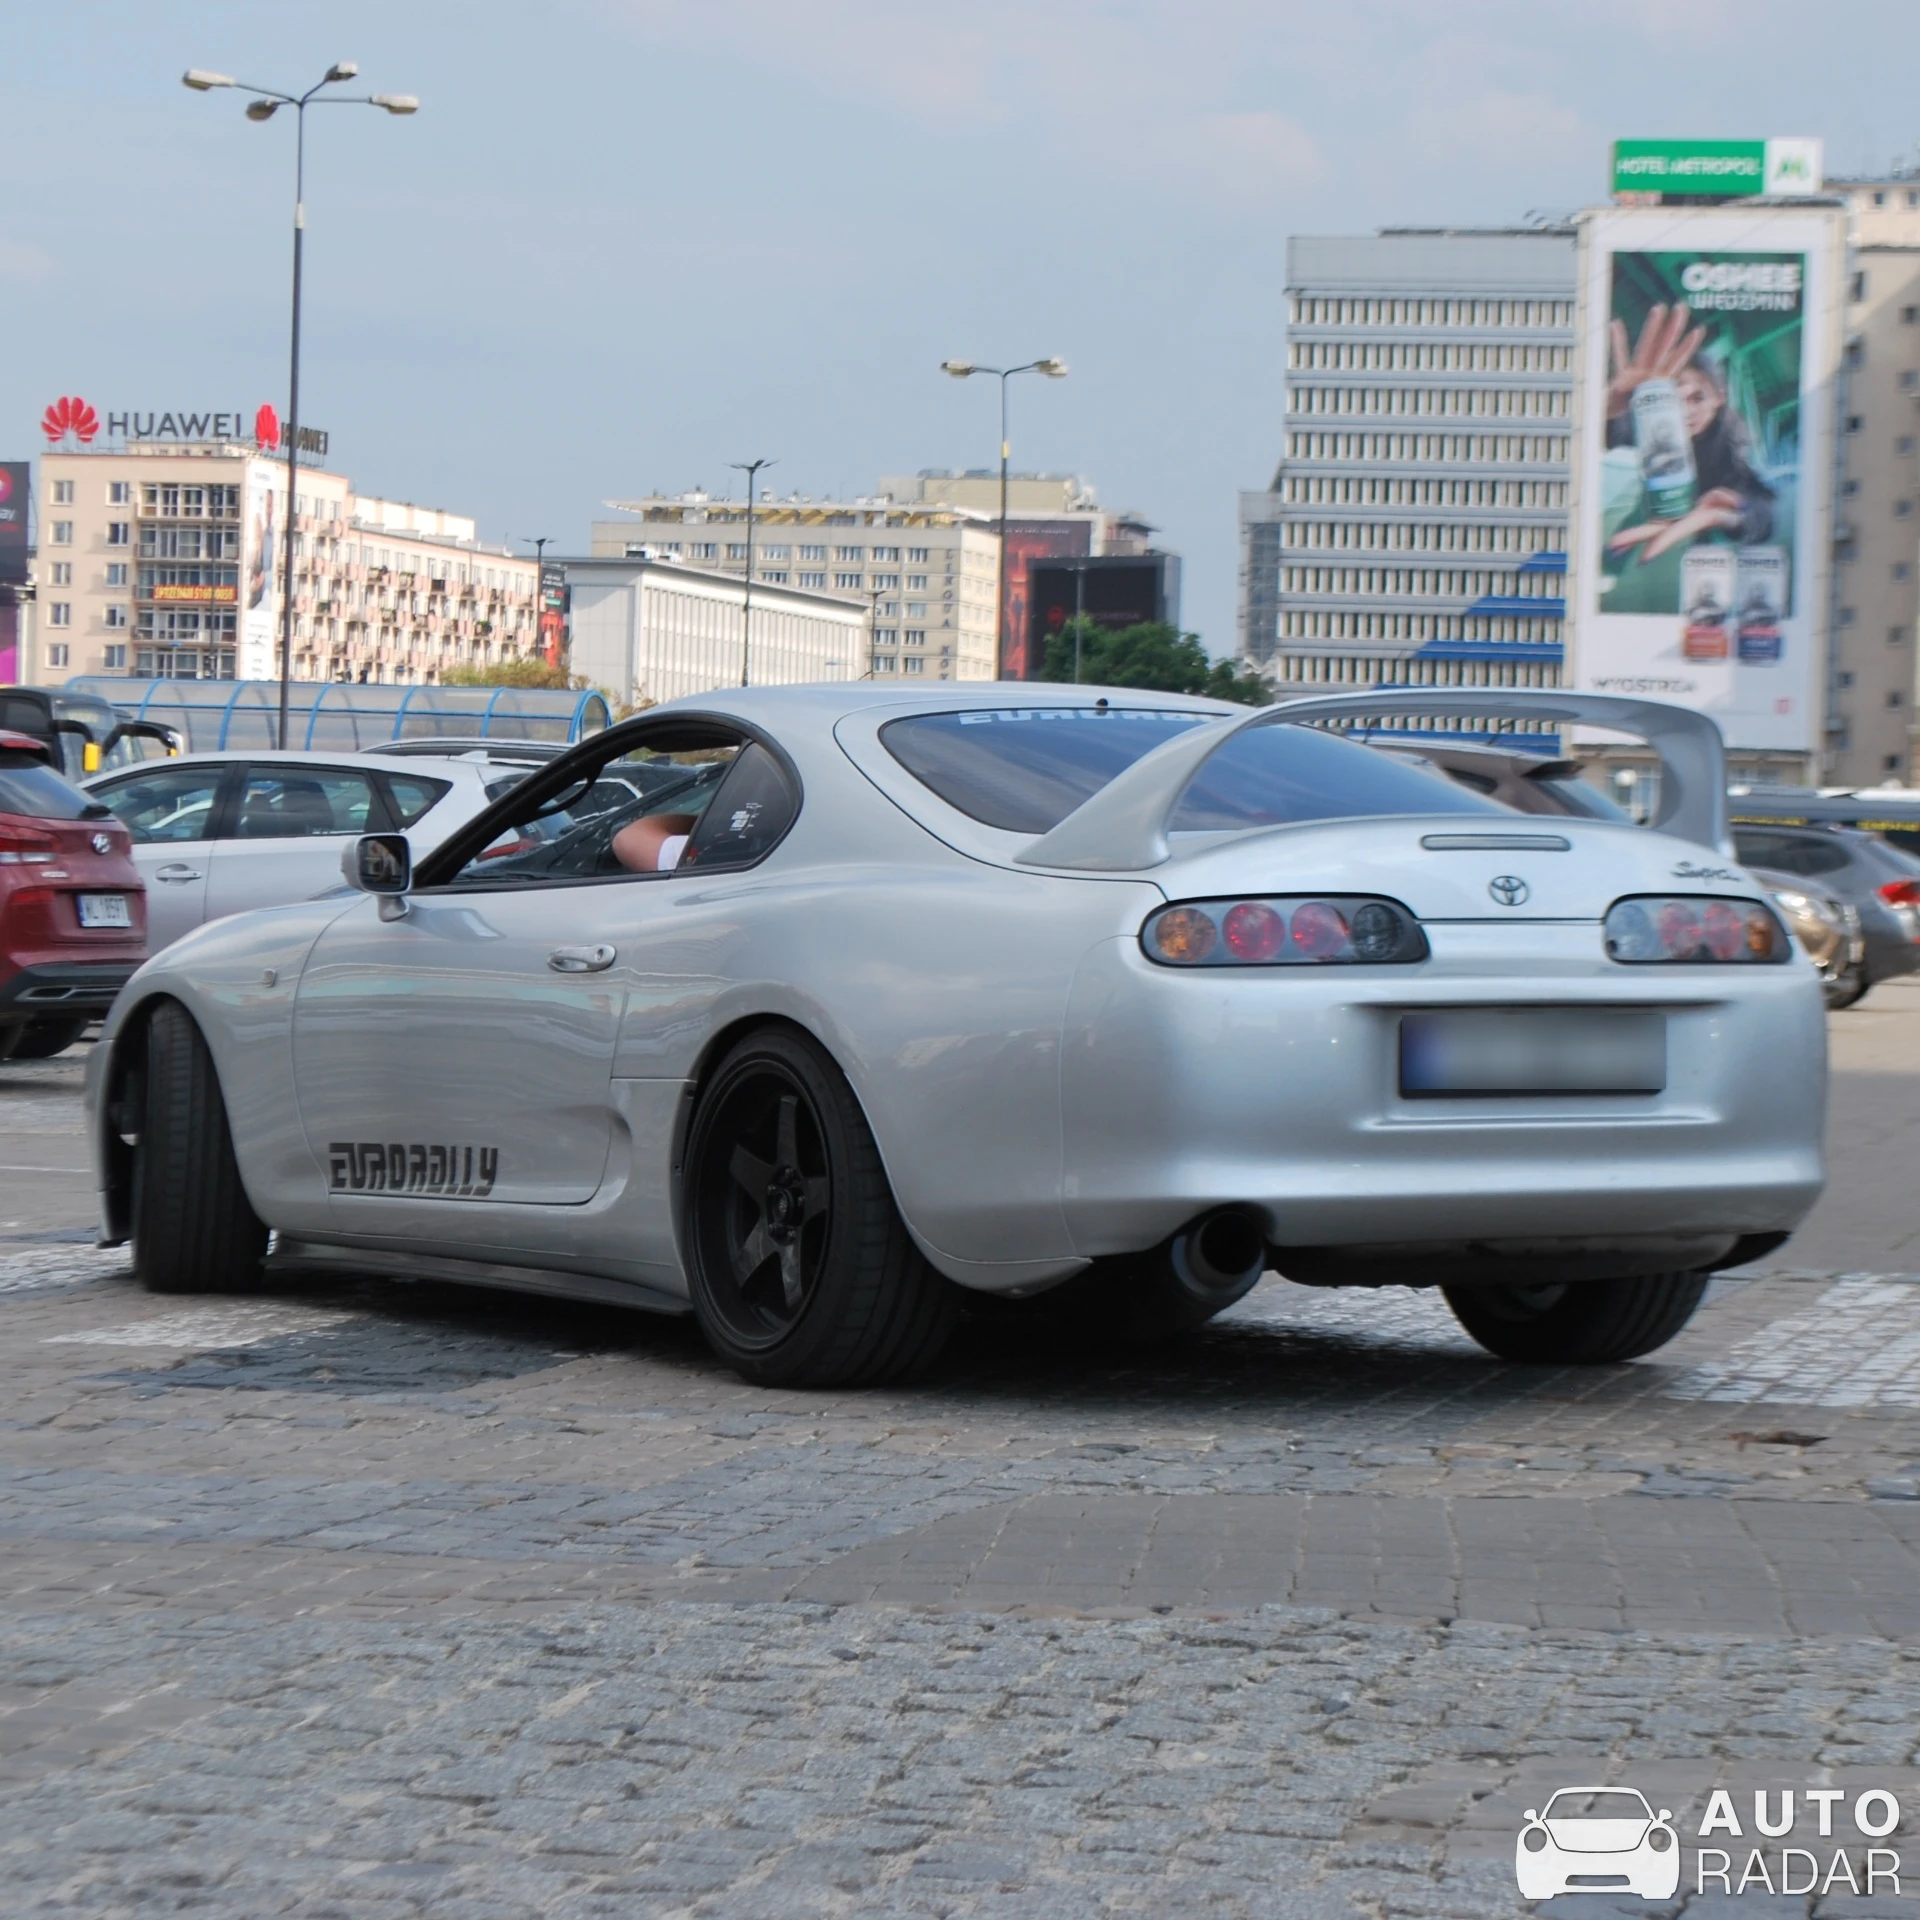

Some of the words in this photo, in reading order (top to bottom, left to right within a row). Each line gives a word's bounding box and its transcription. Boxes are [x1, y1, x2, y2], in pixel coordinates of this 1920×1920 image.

[1616, 156, 1669, 175] HOTEL
[1671, 156, 1760, 176] METROPOL
[1682, 262, 1801, 292] OSHEE
[108, 412, 241, 438] HUAWEI
[281, 422, 329, 455] HAWEI
